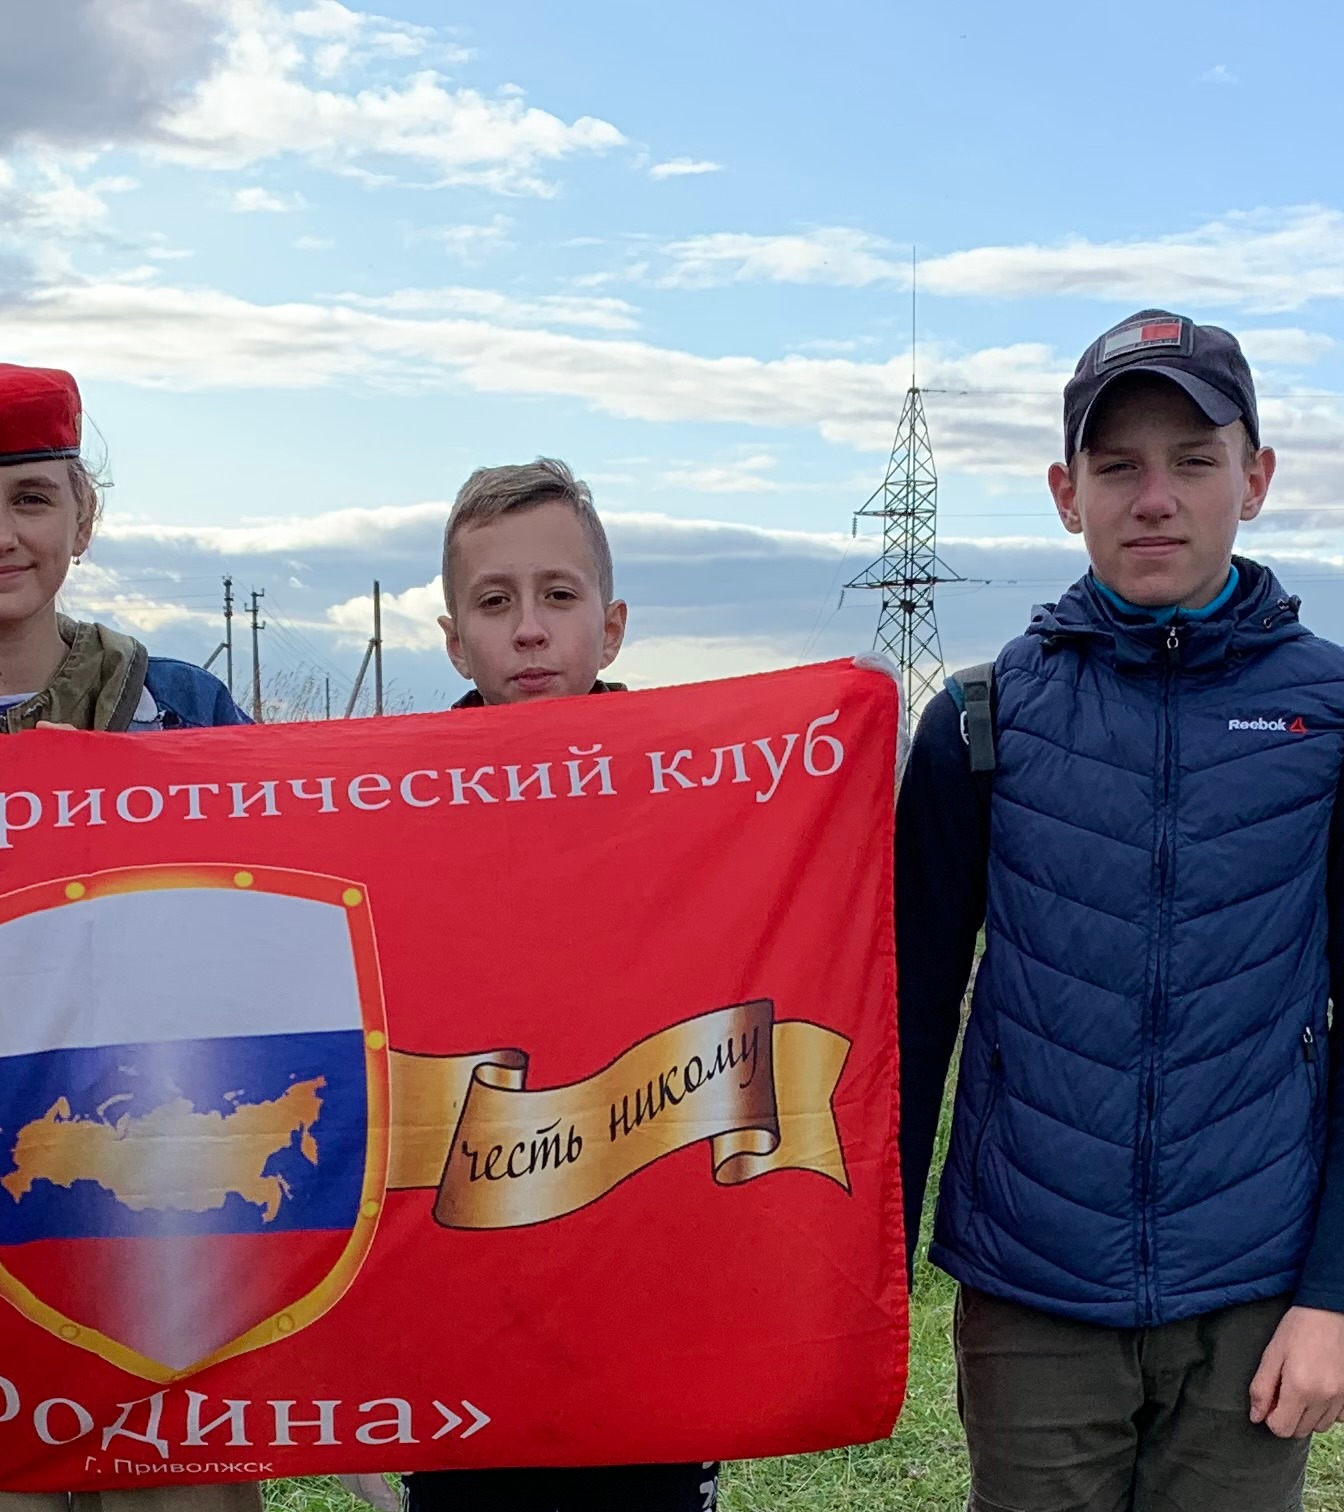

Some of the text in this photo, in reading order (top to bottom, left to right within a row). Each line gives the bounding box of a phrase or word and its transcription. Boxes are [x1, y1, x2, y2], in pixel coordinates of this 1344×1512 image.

[1228, 717, 1287, 731] Reebok
[647, 708, 846, 803] клуб
[459, 1024, 760, 1184] честь никому
[114, 1455, 275, 1476] Приволжск
